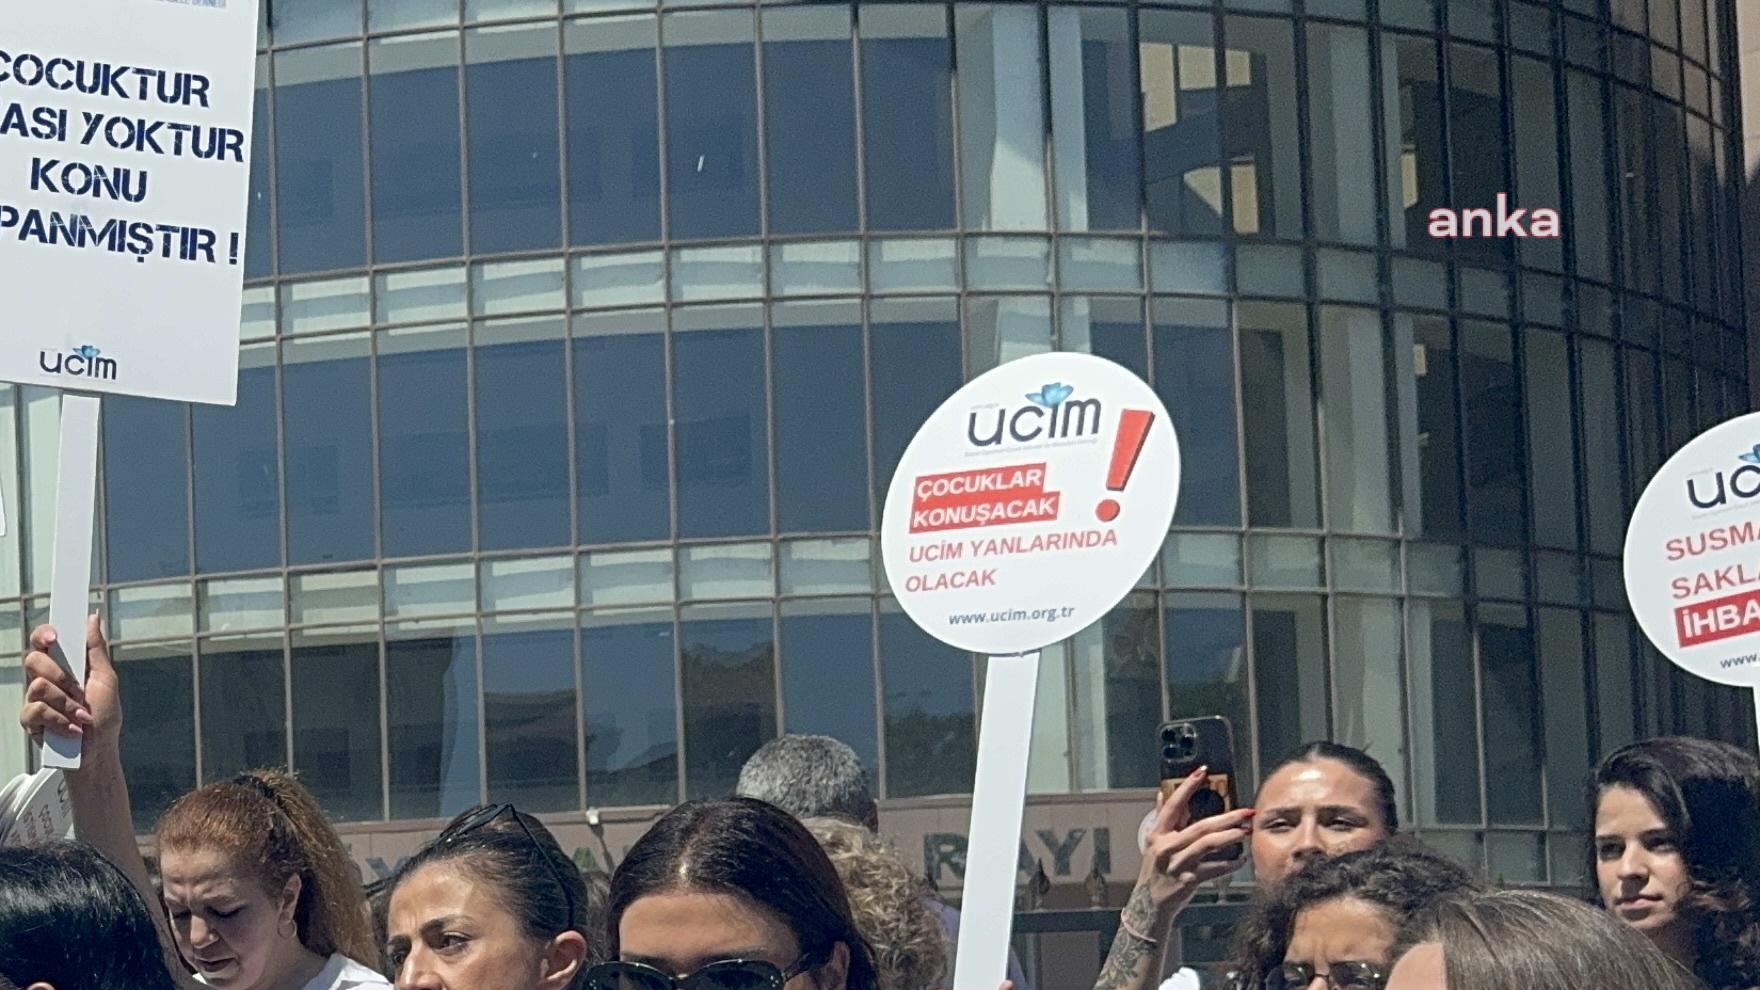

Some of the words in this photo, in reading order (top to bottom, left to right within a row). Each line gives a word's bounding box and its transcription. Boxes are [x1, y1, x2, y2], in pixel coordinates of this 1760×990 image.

[79, 111, 244, 163] YOKTUR
[30, 157, 147, 203] KONU
[228, 231, 239, 265] !
[40, 350, 117, 381] ucim
[967, 398, 1101, 448] ucim
[917, 468, 1042, 502] ÇOCUKLAR
[1687, 465, 1760, 508] uc
[913, 497, 1056, 528] KONUŞACAK
[909, 540, 963, 563] UCİM
[969, 529, 1118, 556] YANLARINDA
[1666, 521, 1760, 561] SUSM
[905, 568, 997, 593] OLACAK
[1671, 563, 1760, 599] SAKL
[948, 605, 1075, 625] www.ucim.org.tr
[1683, 599, 1760, 638] İHBA
